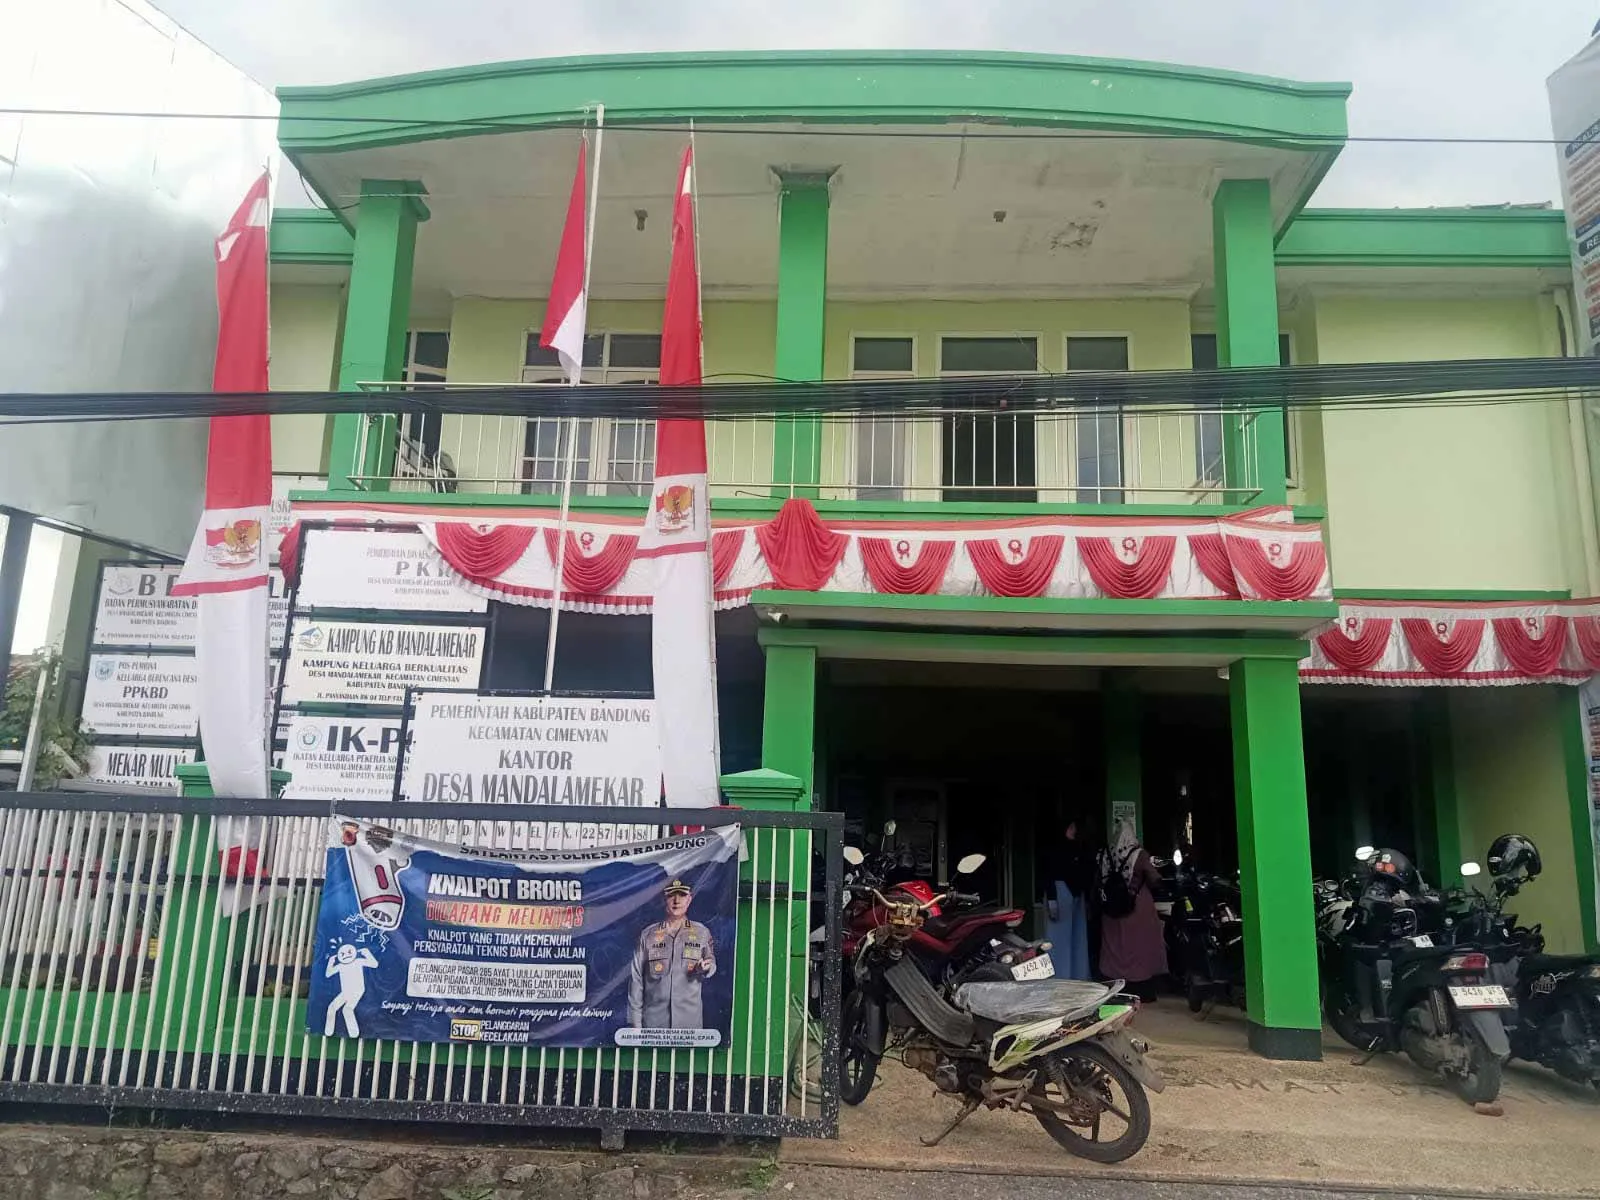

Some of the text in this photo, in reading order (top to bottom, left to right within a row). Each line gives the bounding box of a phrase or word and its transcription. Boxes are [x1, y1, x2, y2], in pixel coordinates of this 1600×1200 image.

[327, 628, 477, 659] KAMPUNG KB MANDALAMEKAR
[302, 660, 469, 675] KAMPUNG KELUARGA BERKUALITAS
[123, 686, 168, 699] PPKBD
[346, 681, 386, 690] KABUPATEN
[431, 704, 651, 722] PEMERINTAH KABUPATEN BANDUNG
[469, 726, 609, 743] KECAMATAN CIMENYAN
[107, 752, 148, 777] MEKAR
[499, 750, 573, 770] KANTOR
[423, 773, 645, 806] DESA MANDALAMEKAR
[428, 873, 582, 901] KNALPOT BRONG
[426, 900, 584, 928] DILARANG MELINTAS
[428, 928, 572, 947] KNALPOT YANG TIDAK MEMENUHI
[414, 940, 586, 959] PERSYARATAN TEKNIS DAN LAIK JALAN
[412, 973, 442, 984] DENGAN
[443, 975, 468, 986] PIDANA
[469, 976, 507, 988] KURUNGAN
[508, 978, 533, 988] PALING
[534, 979, 553, 989] LAMA
[559, 979, 583, 989] BULAN
[493, 968, 511, 978] AYAT
[426, 983, 446, 994] ATAU
[447, 984, 471, 996] DENDA
[472, 986, 496, 997] PALING
[497, 988, 525, 998] BANYAK
[381, 1000, 413, 1016] Sayangi
[414, 1001, 444, 1017] telinga
[444, 1005, 467, 1014] anda
[468, 1006, 484, 1015] dan
[518, 1007, 558, 1022] pengguna
[558, 1007, 582, 1021] jalan
[452, 1020, 530, 1037] STOP PELANGGARAN
[479, 1031, 529, 1043] KECELAKAAN
